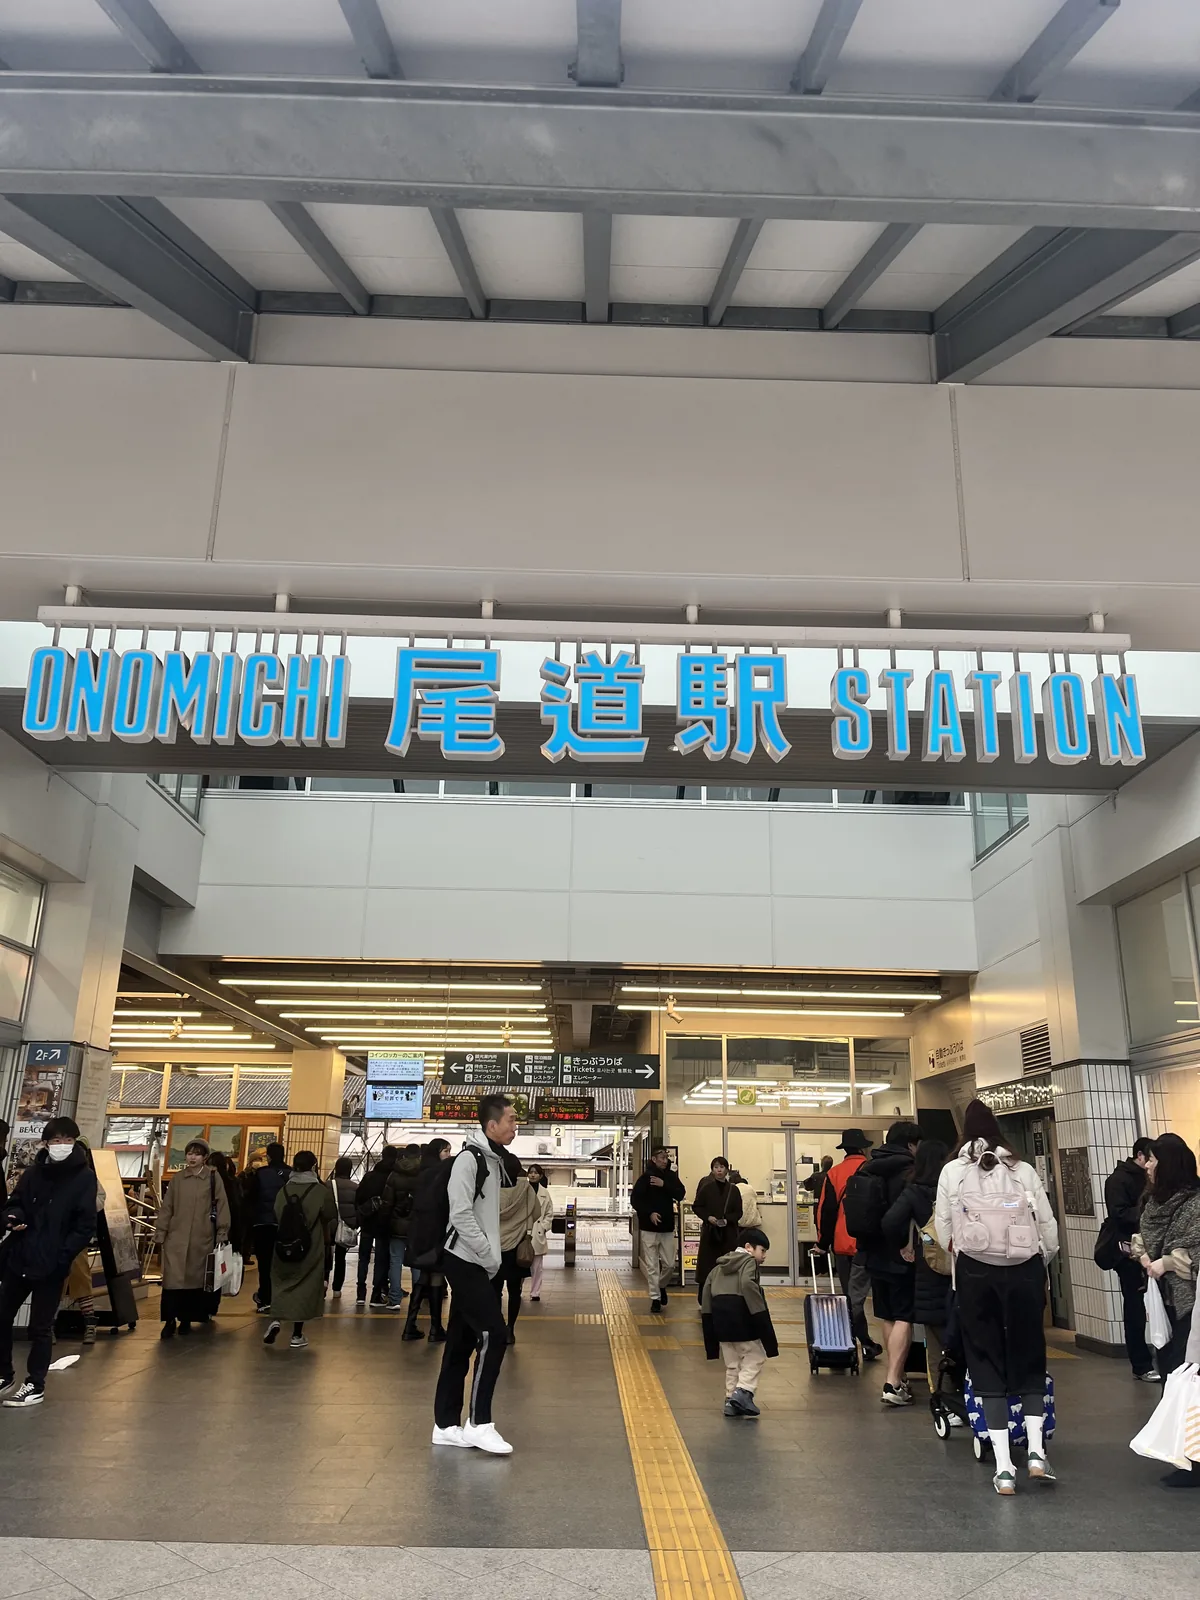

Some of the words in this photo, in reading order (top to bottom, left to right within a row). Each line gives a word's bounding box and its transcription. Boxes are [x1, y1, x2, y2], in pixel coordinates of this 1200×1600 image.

[22, 646, 351, 749] ONOMICHI
[384, 645, 793, 764] 尾道駅
[830, 666, 1147, 767] STATION
[35, 1049, 48, 1060] 2F
[572, 1057, 623, 1066] きっぷうりば
[19, 1125, 44, 1133] BEACO
[555, 1128, 561, 1136] 2
